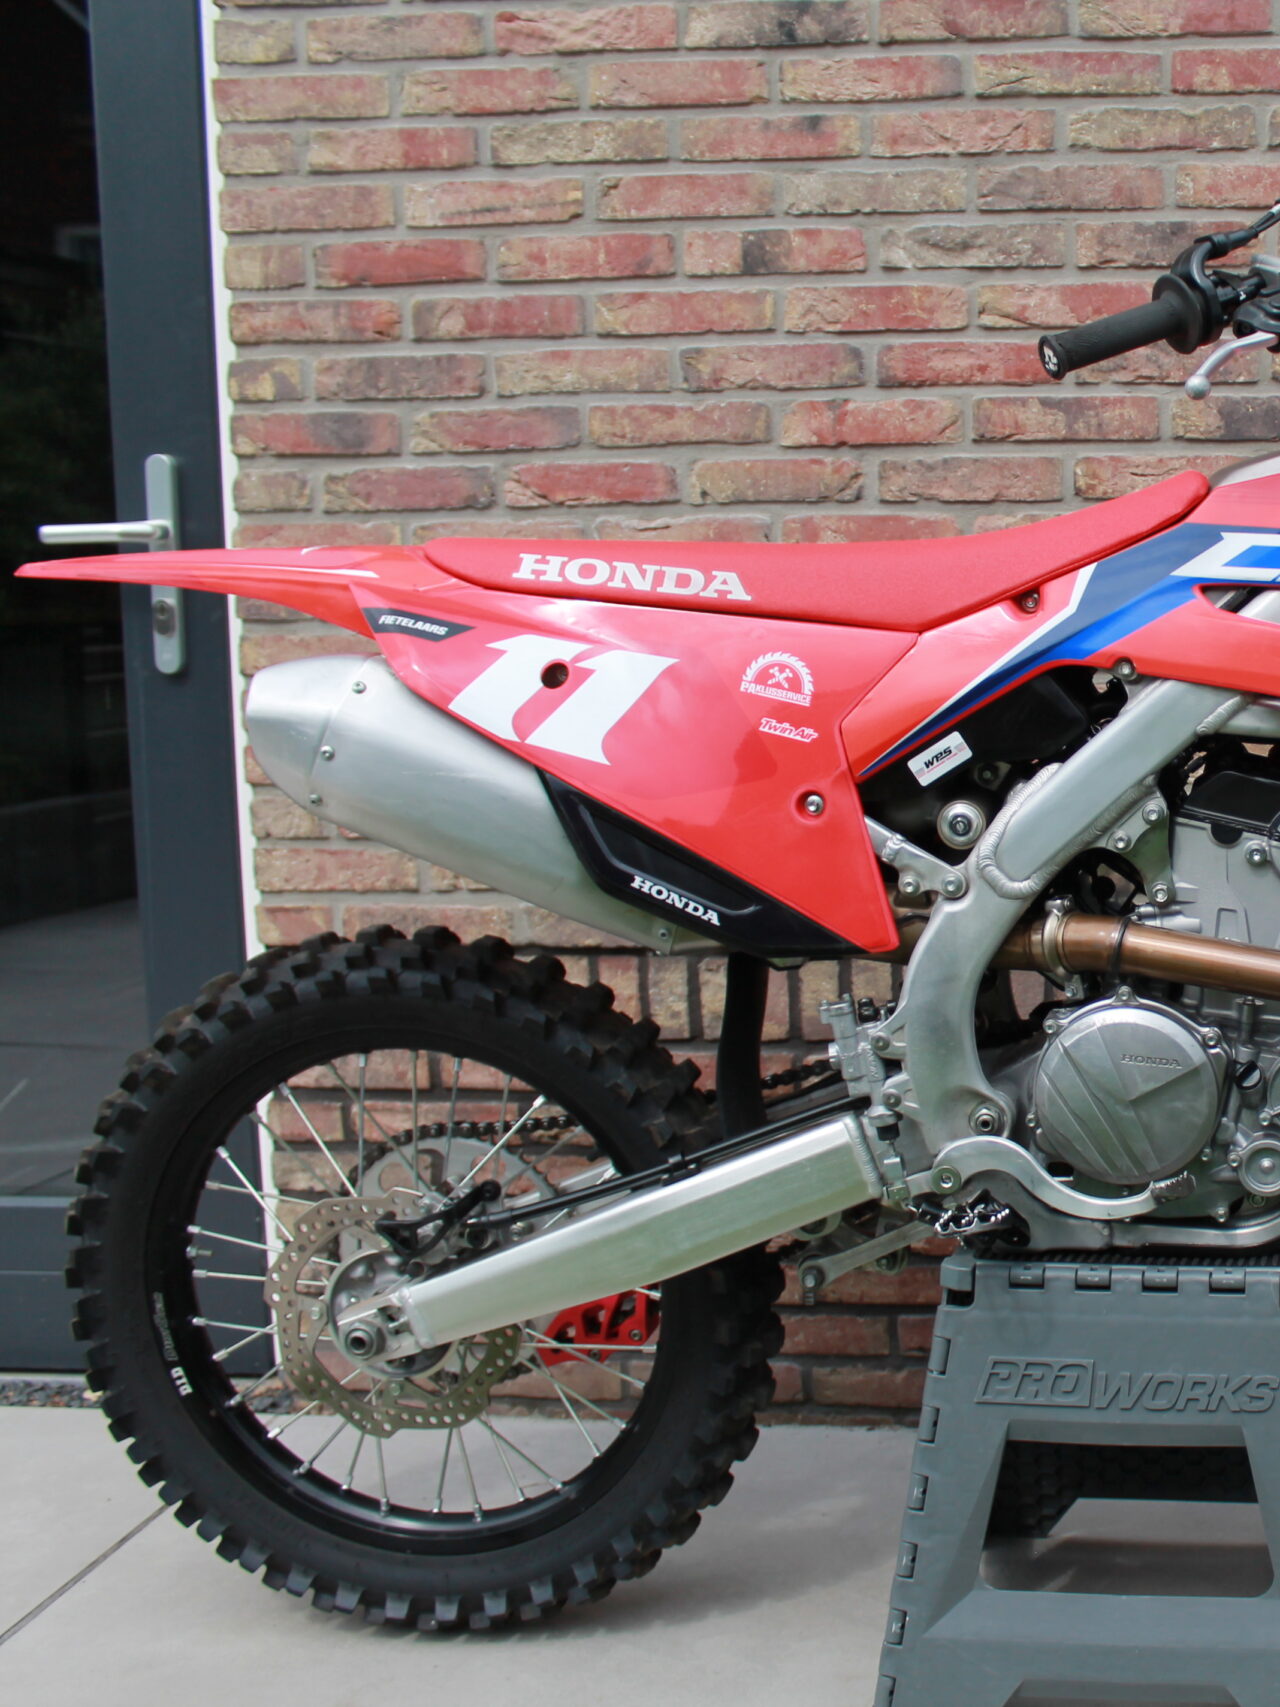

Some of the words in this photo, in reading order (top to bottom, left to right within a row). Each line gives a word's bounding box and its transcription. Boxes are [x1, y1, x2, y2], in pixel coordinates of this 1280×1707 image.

[511, 553, 753, 601] HONDA
[378, 614, 449, 636] FIETELAARS
[448, 634, 680, 766] 11
[759, 717, 794, 737] Twin
[793, 726, 819, 742] Air
[924, 746, 953, 769] WPS
[630, 875, 721, 927] HONDA
[1120, 1054, 1182, 1069] HONDA
[1095, 1371, 1280, 1413] WORKS
